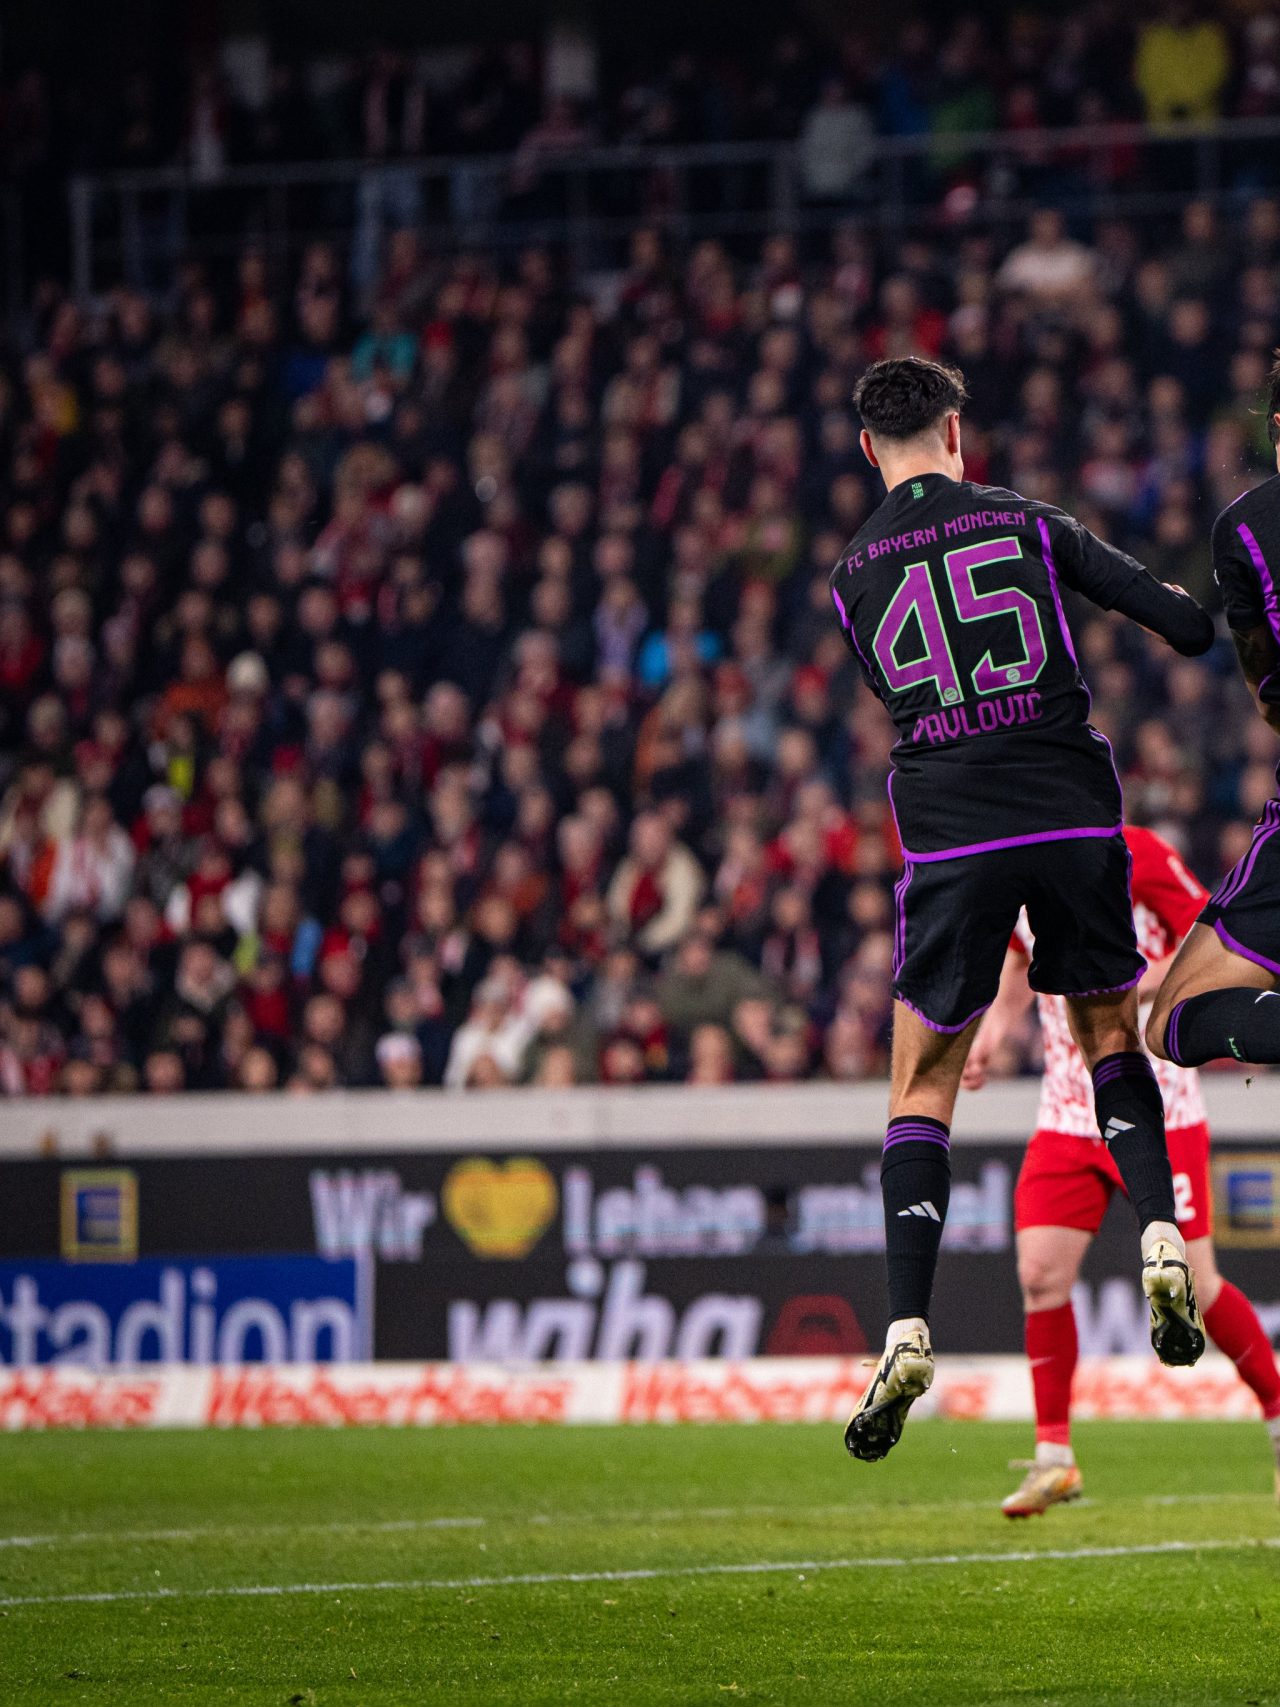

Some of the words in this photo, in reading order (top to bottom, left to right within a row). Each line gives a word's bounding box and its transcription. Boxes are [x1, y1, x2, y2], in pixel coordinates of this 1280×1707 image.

[847, 552, 865, 576] FC
[868, 525, 938, 560] BAYERN
[872, 535, 1048, 707] 45
[0, 1266, 357, 1368] tadion
